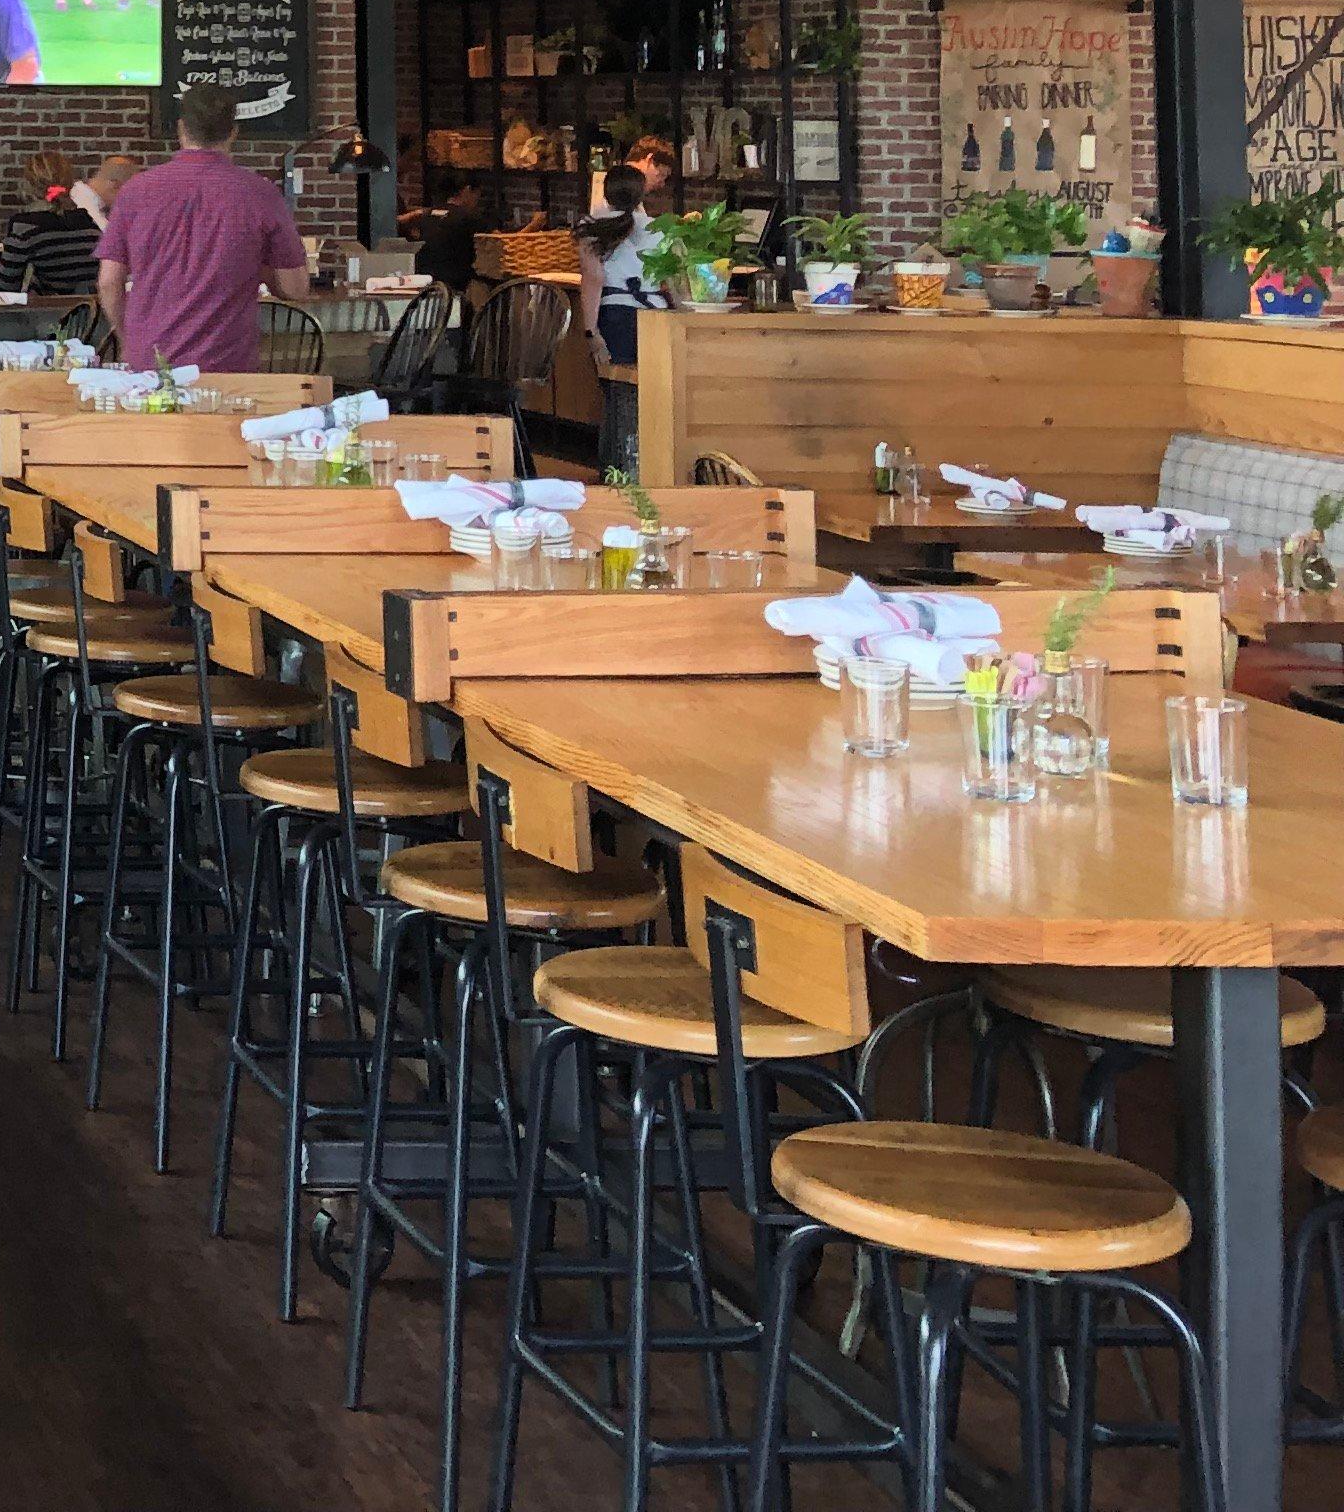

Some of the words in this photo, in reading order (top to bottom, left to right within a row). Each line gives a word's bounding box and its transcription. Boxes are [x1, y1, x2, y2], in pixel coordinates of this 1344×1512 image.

[186, 72, 217, 84] 1792
[1041, 80, 1098, 110] DINNER
[1270, 129, 1338, 162] AGE
[1056, 180, 1113, 202] AUGUST
